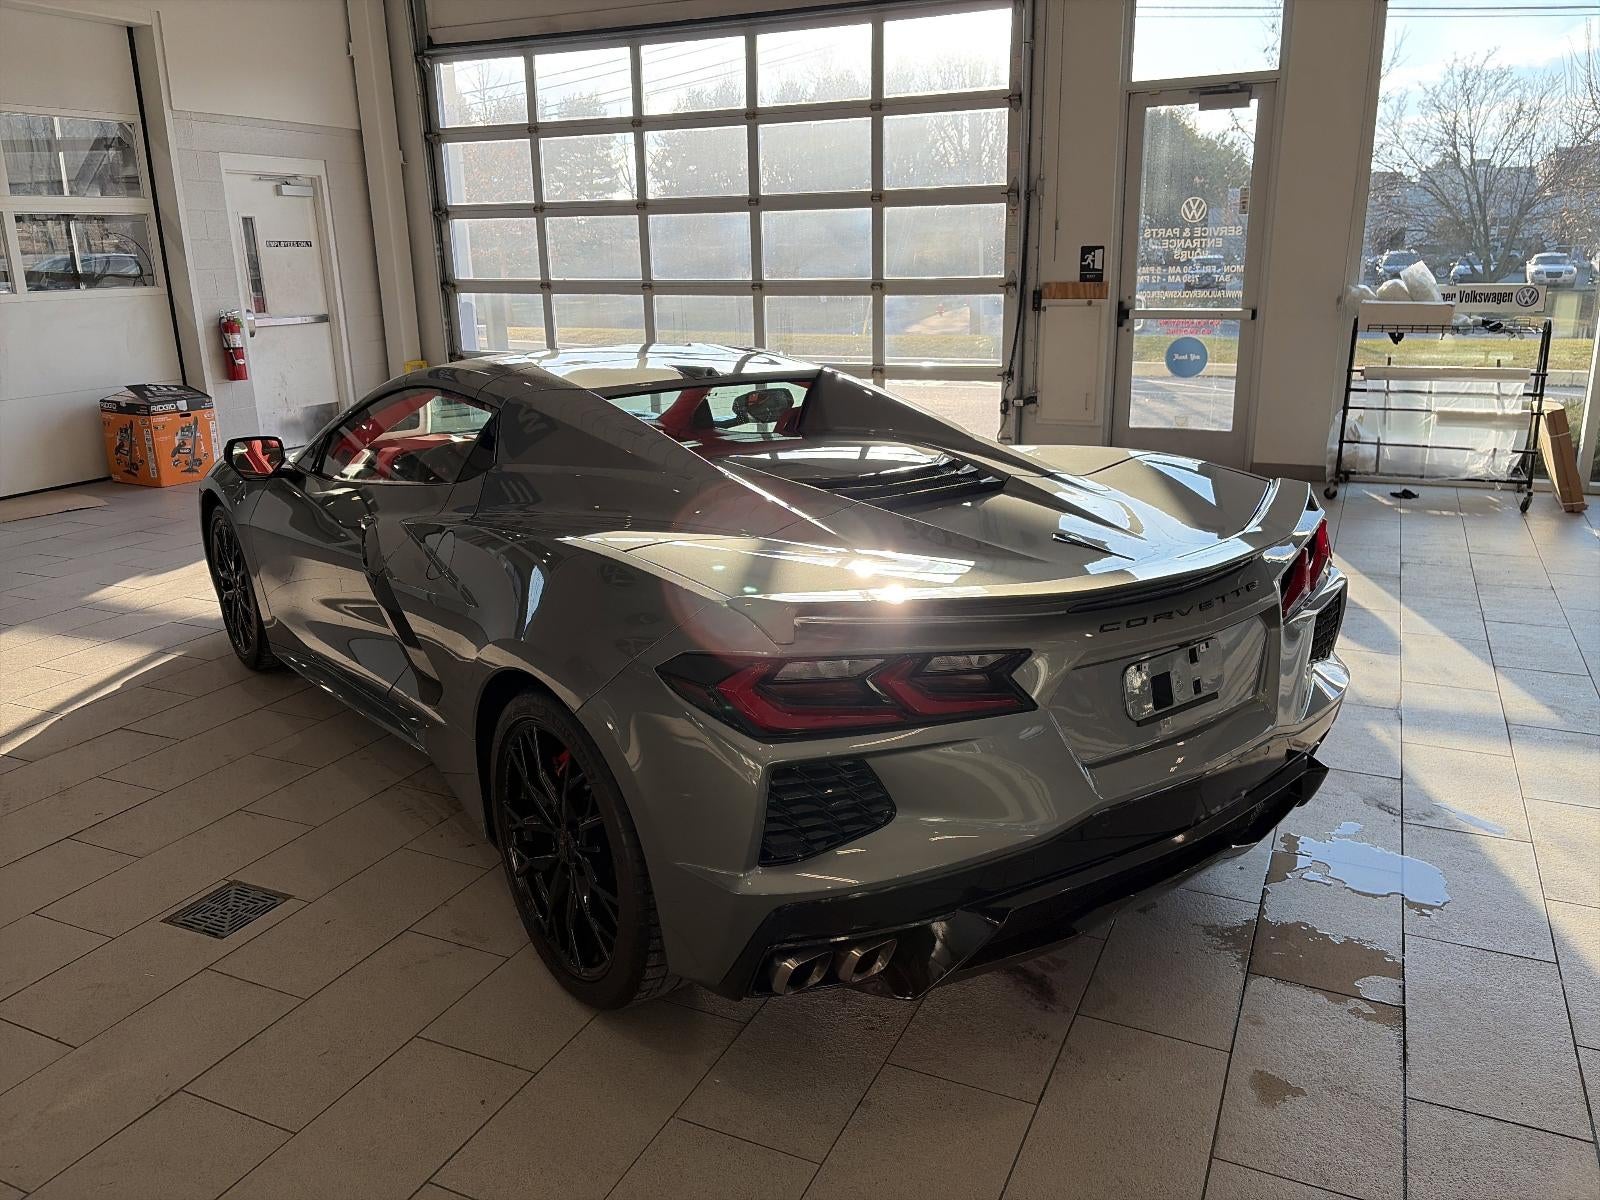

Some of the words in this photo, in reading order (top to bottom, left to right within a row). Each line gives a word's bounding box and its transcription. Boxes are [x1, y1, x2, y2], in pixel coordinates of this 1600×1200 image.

[1459, 290, 1513, 305] Volkswagen
[150, 403, 176, 412] RIDGID
[1099, 581, 1258, 633] CORVETTE
